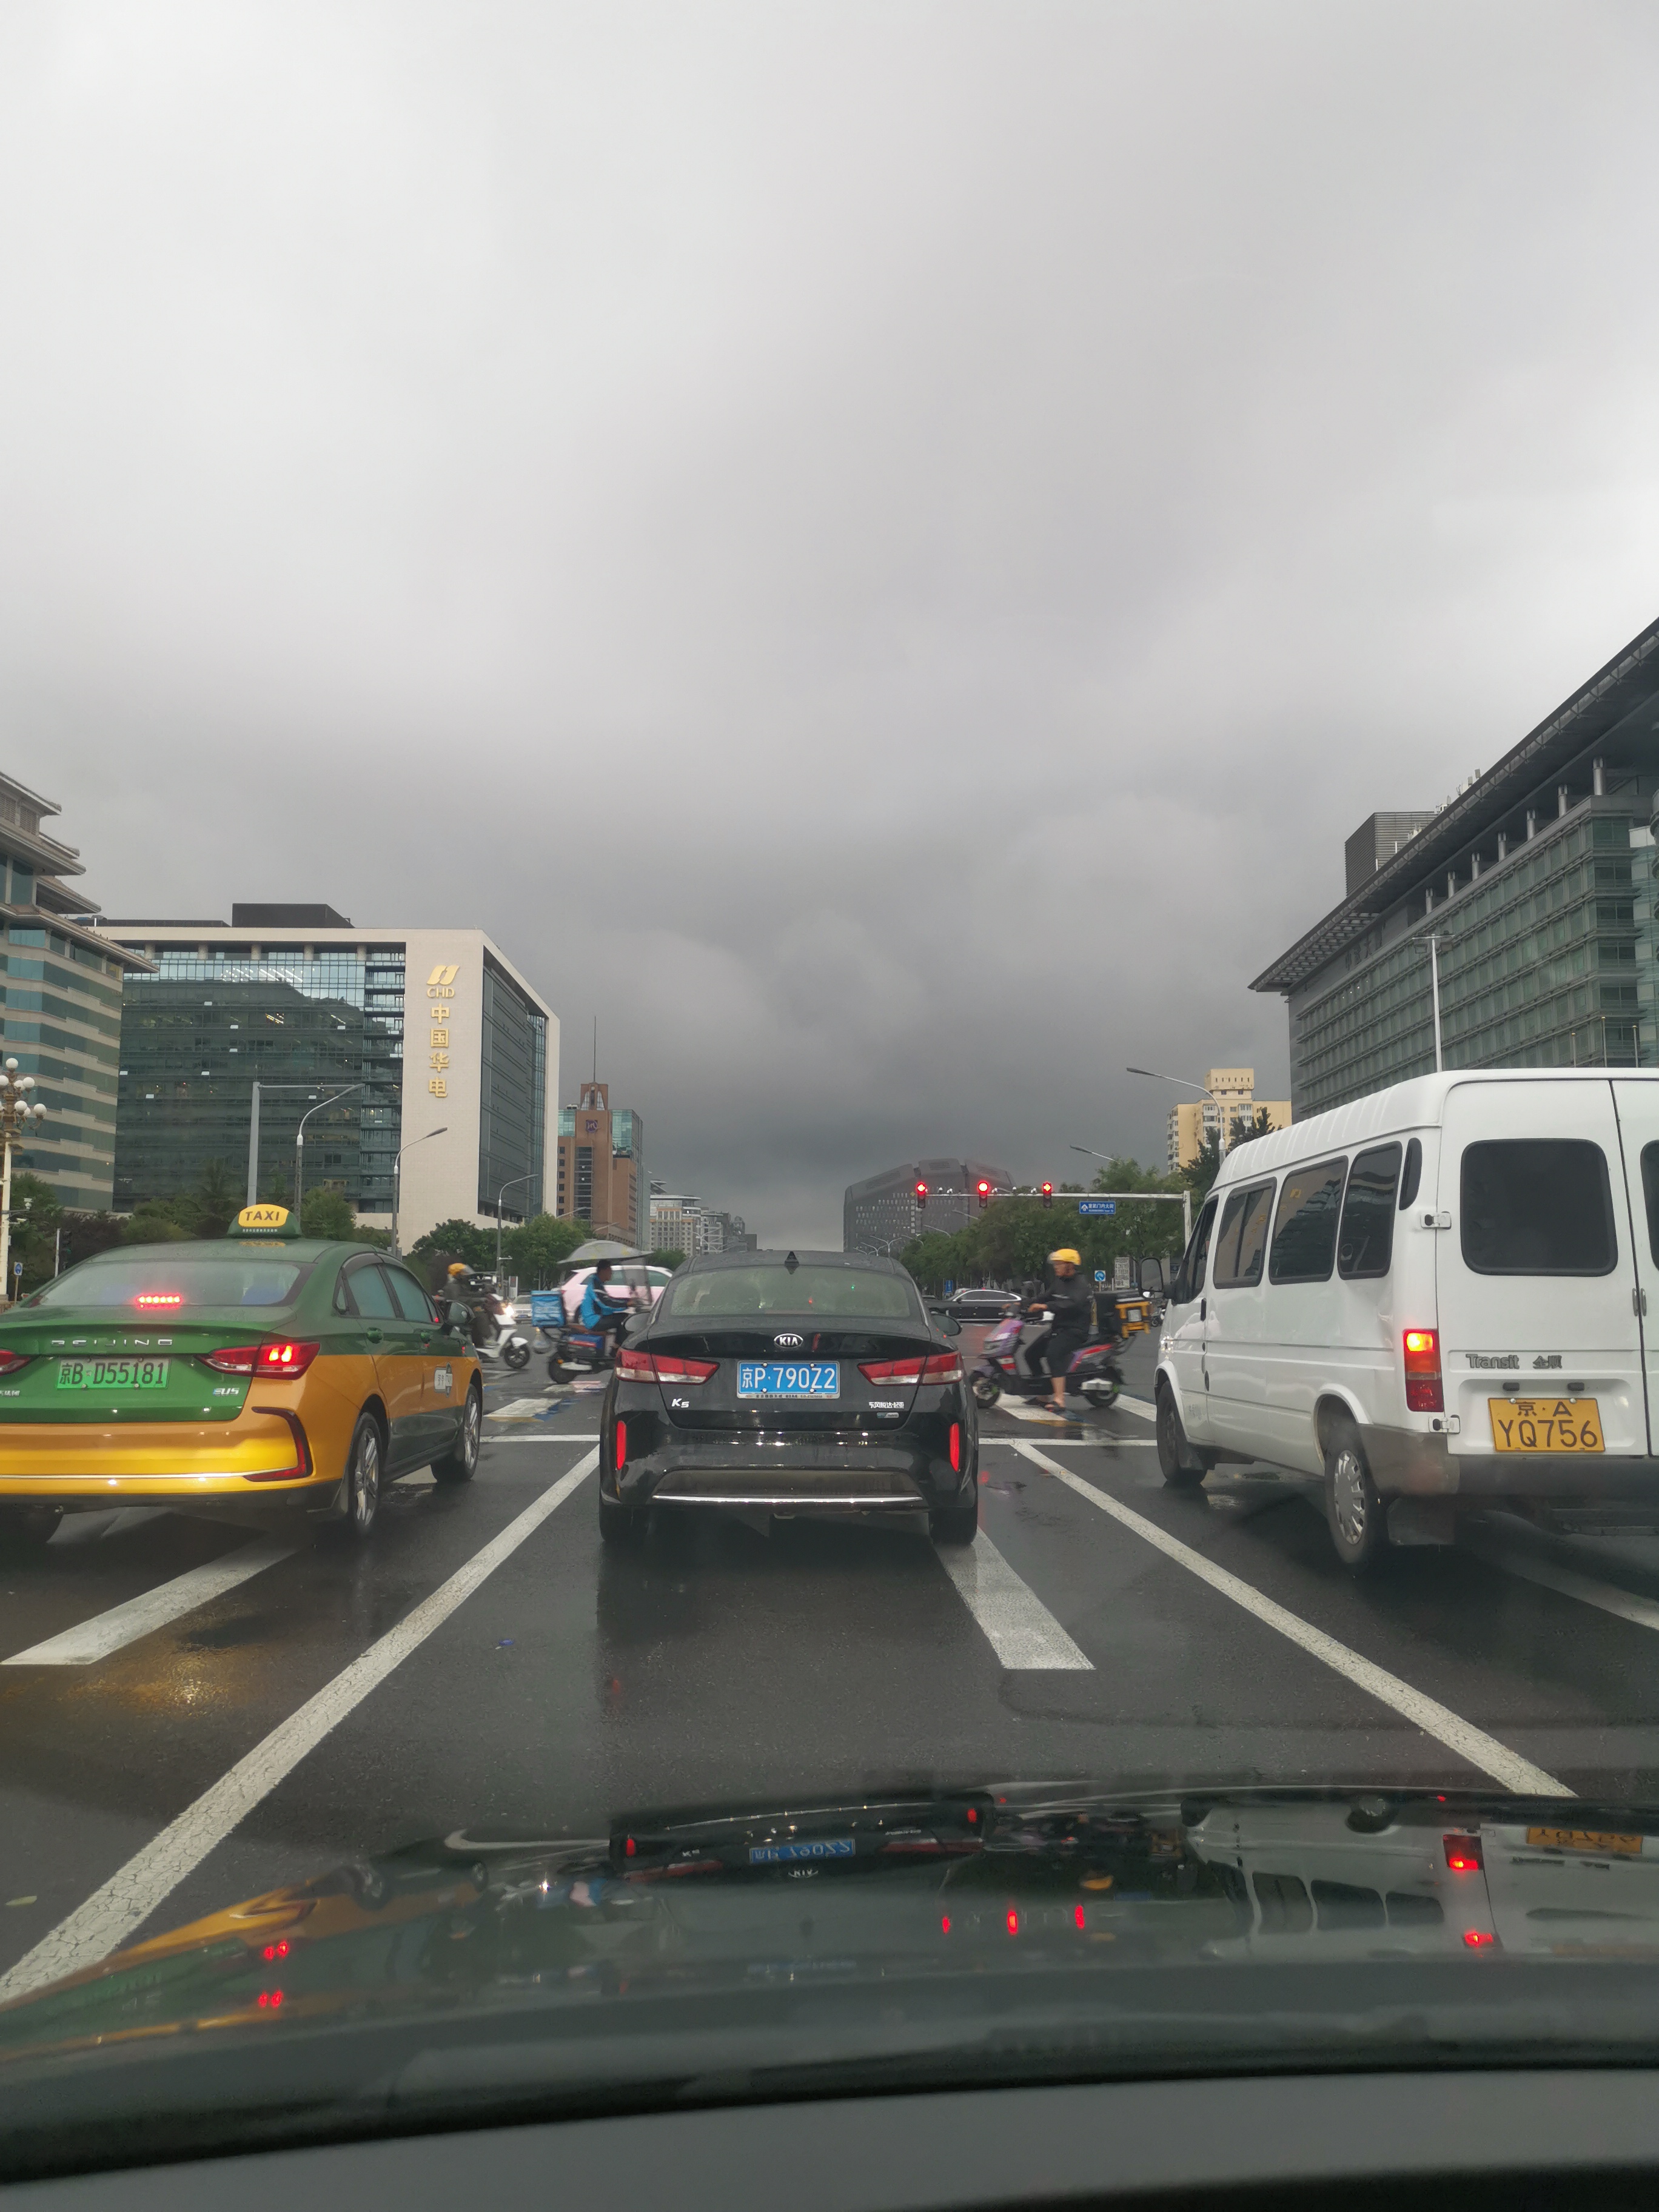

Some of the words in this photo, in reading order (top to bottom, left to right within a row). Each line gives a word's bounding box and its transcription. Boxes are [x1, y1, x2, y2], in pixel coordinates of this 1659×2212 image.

[427, 987, 455, 998] CHD
[429, 1003, 450, 1098] 中国华电
[246, 1210, 280, 1221] TAXI
[779, 1336, 799, 1346] KIA
[1466, 1353, 1520, 1369] Transit
[1533, 1355, 1562, 1369] 全顺
[1498, 1419, 1598, 1448] YQ756
